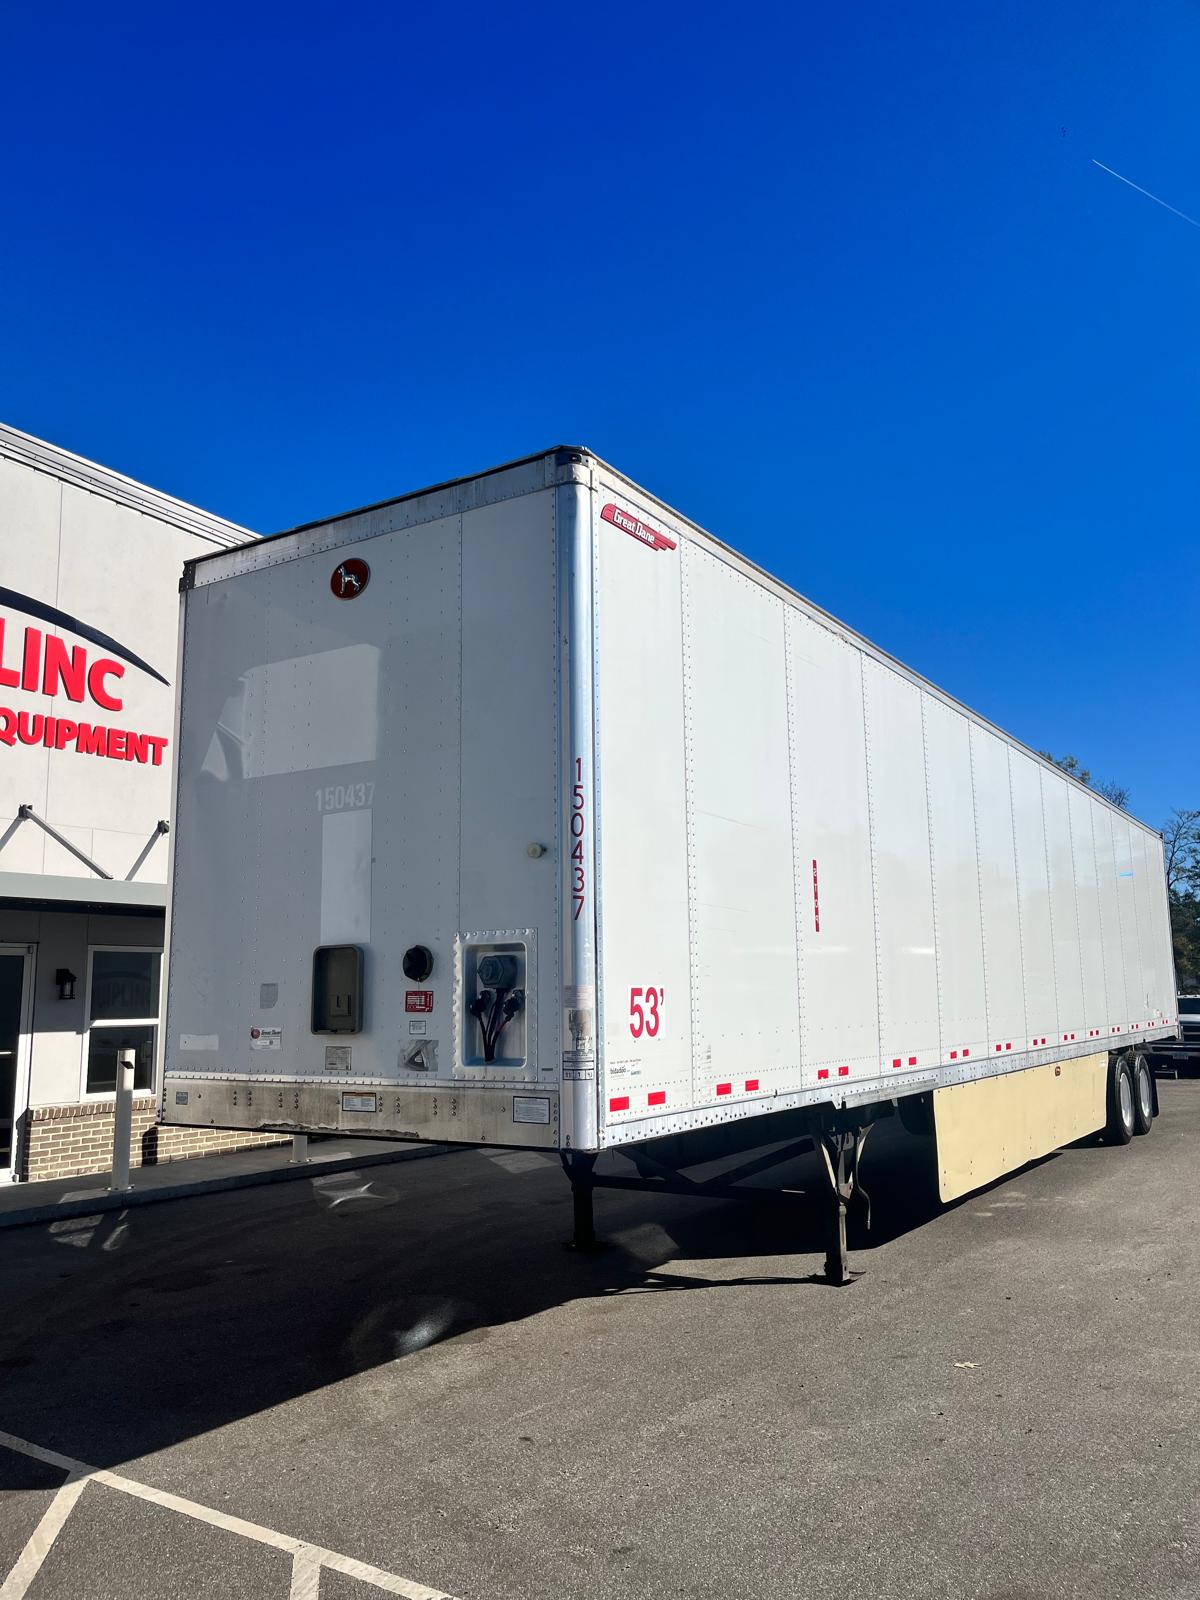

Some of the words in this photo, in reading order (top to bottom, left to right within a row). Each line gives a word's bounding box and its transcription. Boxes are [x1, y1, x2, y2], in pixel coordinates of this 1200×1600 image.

[613, 509, 636, 533] Great
[635, 521, 655, 544] Dane
[0, 617, 126, 712] LINC
[314, 782, 376, 812] 150437
[570, 757, 585, 921] 150437
